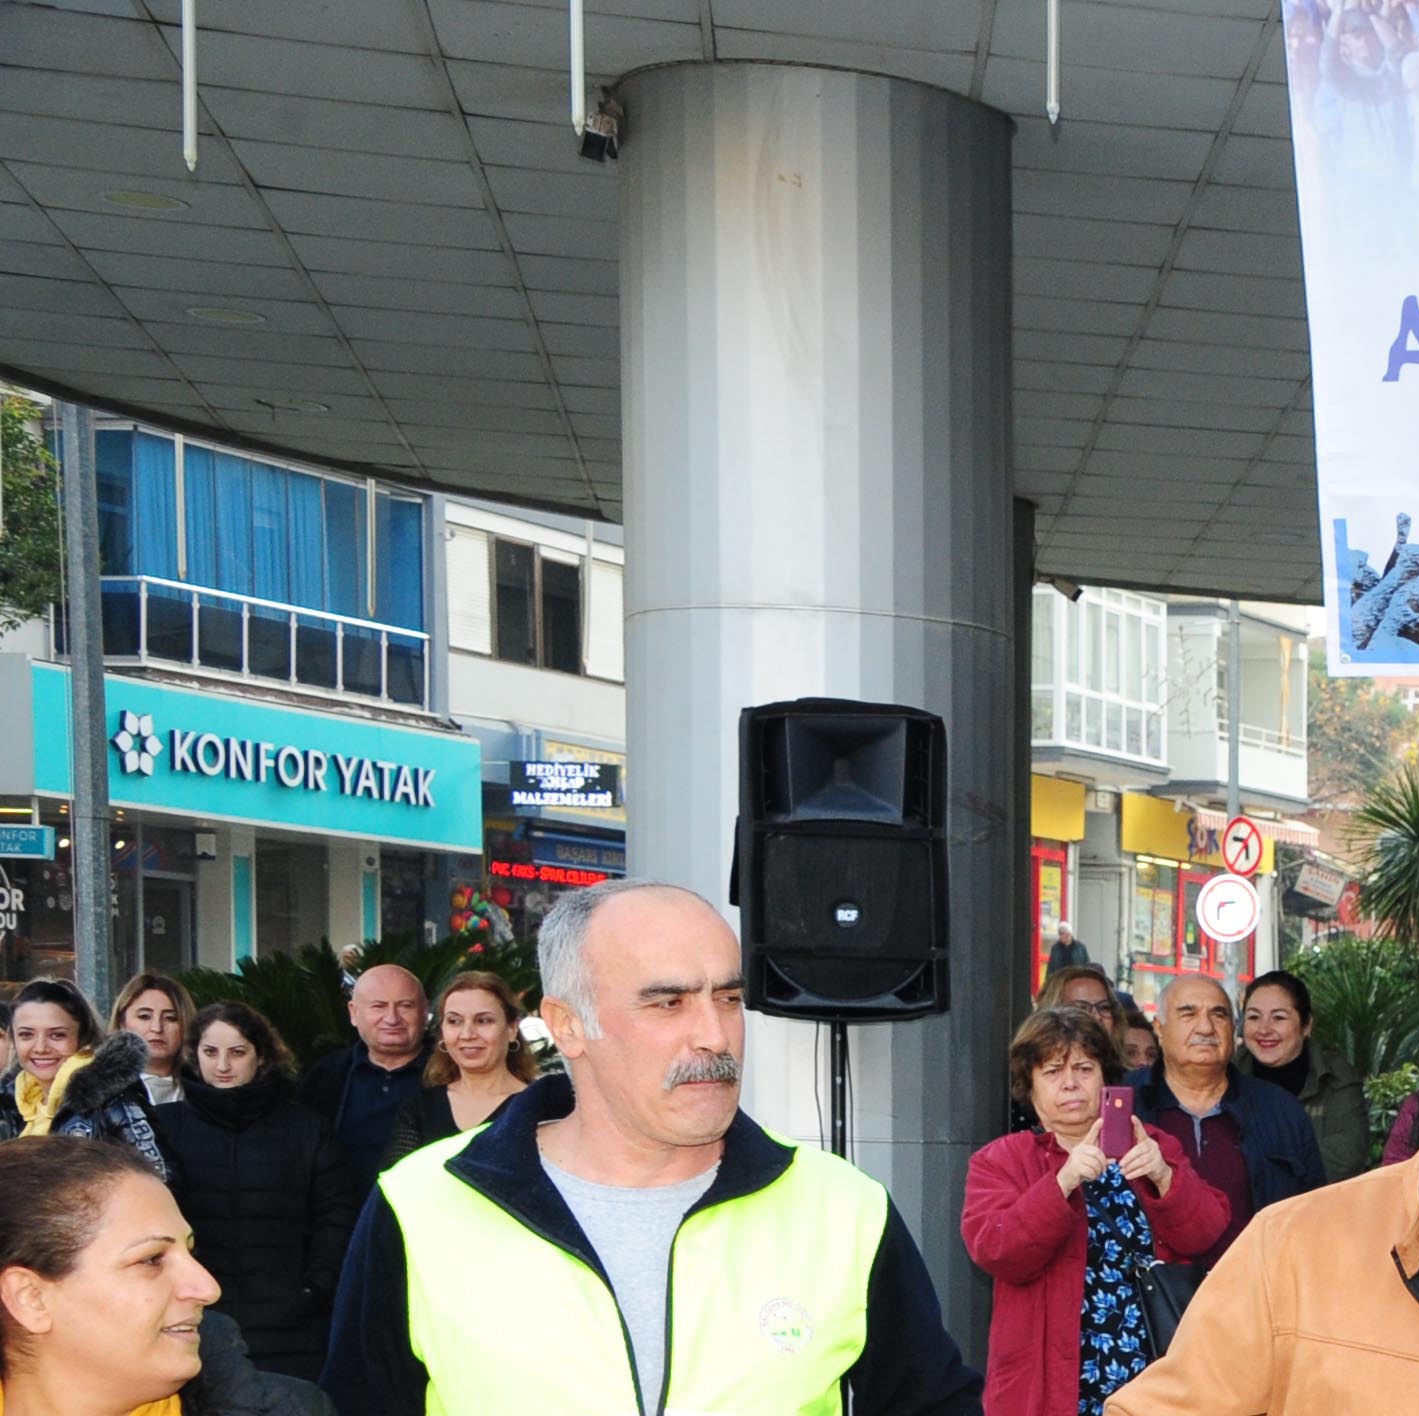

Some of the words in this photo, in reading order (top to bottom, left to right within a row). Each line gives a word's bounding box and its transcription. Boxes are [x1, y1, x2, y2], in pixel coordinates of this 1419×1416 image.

[169, 729, 328, 792] KONFOR
[335, 753, 436, 808] YATAK
[0, 886, 25, 911] OR
